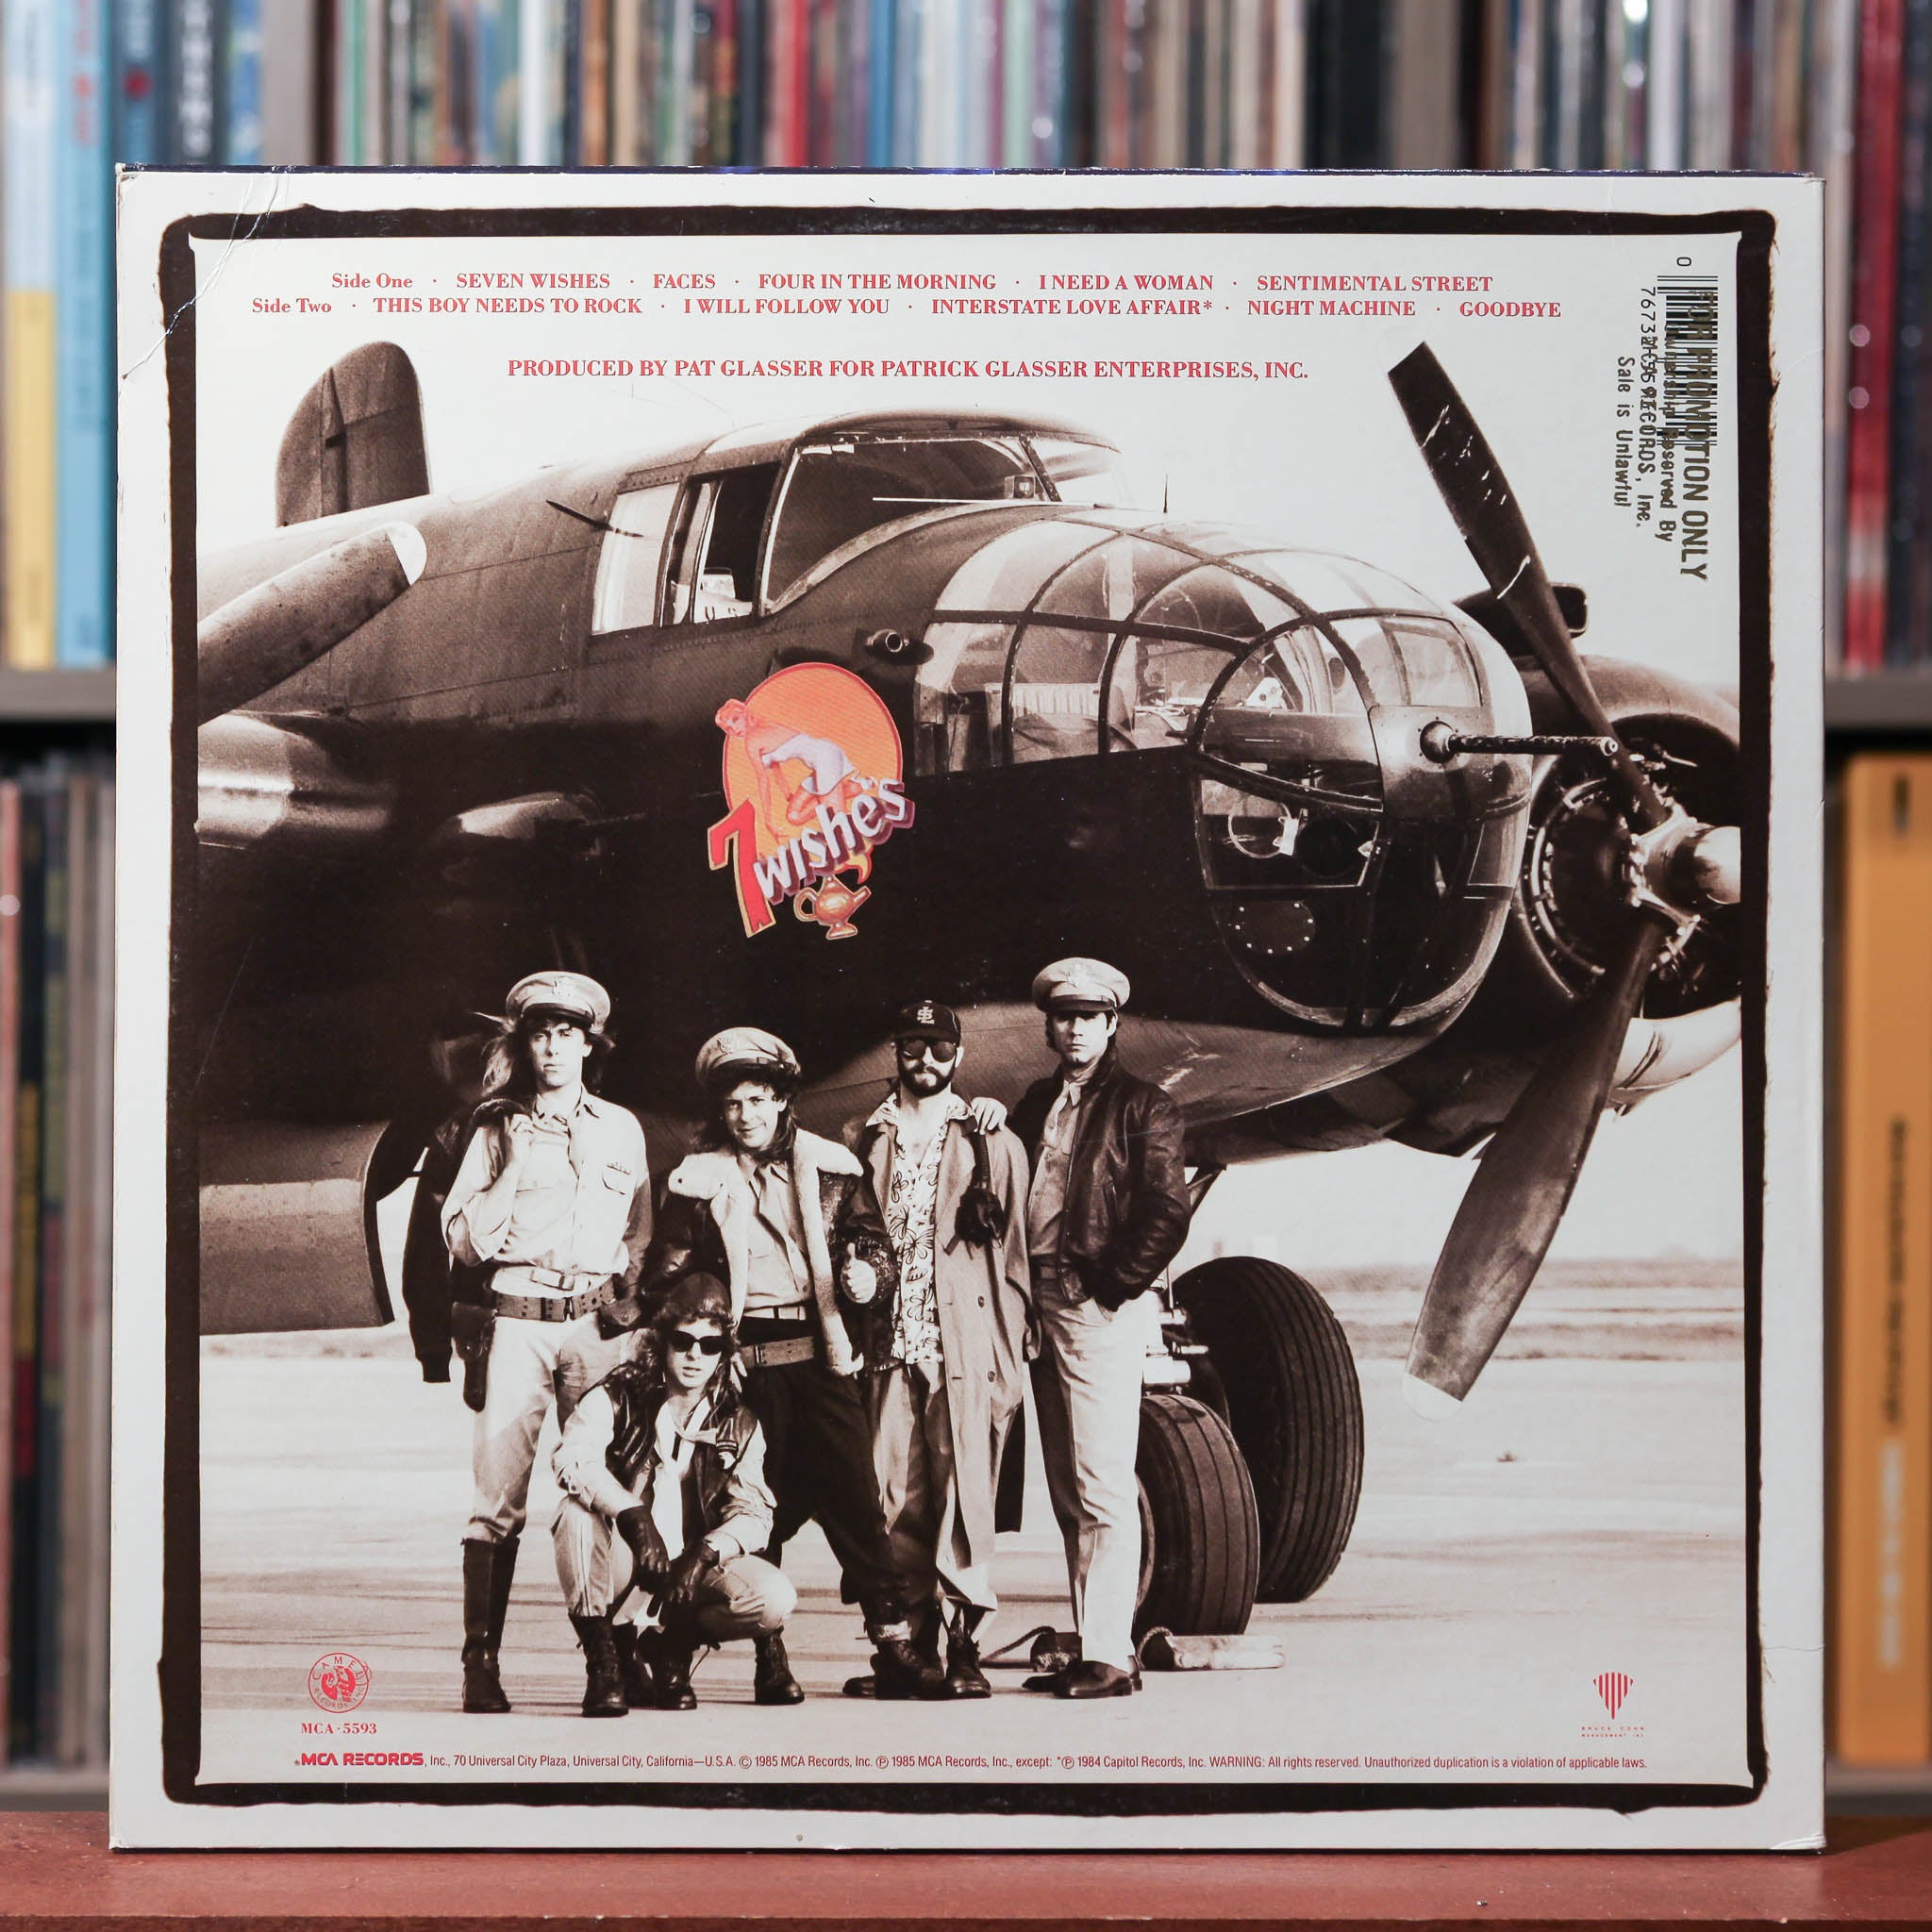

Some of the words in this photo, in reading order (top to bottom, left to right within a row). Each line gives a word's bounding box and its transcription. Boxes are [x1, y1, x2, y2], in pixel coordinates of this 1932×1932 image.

[331, 272, 371, 289] Side
[375, 272, 413, 289] One
[456, 273, 525, 289] SEVEN
[528, 273, 610, 289] WISHES
[652, 273, 716, 290] FACES
[758, 273, 816, 290] FOUR
[820, 274, 843, 290] IN
[847, 274, 891, 290] THE
[896, 274, 997, 291] MORNING
[1039, 274, 1047, 291] I
[1051, 274, 1110, 291] NEED
[1114, 275, 1129, 291] A
[1133, 275, 1214, 291] WOMAN
[1257, 275, 1407, 291] SENTIMENTAL
[1410, 275, 1493, 292] STREET
[252, 297, 291, 313] Side
[295, 297, 332, 313] Two
[373, 297, 423, 313] THIS
[428, 297, 471, 313] BOY
[475, 297, 545, 314] NEEDS
[549, 297, 579, 314] TO
[583, 297, 642, 314] ROCK
[683, 298, 691, 314] I
[695, 298, 751, 314] WILL
[754, 298, 843, 315] FOLLOW
[846, 298, 890, 314] YOU
[931, 298, 1061, 315] INTERSTATE
[1066, 298, 1122, 315] LOVE
[1247, 299, 1315, 316] NIGHT
[1319, 299, 1416, 317] MACHINE
[1458, 301, 1561, 318] GOODBYE
[1686, 289, 1715, 341] FOR
[508, 359, 634, 377] PRODUCED
[638, 359, 668, 376] BY
[674, 359, 716, 376] PAT
[720, 359, 824, 377] GLASSER
[828, 359, 875, 377] FOR
[880, 359, 980, 377] PATRICK
[985, 359, 1089, 378] GLASSER
[1093, 360, 1259, 382] ENTERPRISES,
[1264, 361, 1308, 379] INC.
[1616, 357, 1635, 393] Sale
[1616, 404, 1634, 418] is
[1681, 346, 1712, 502] PROMOTION
[1614, 430, 1633, 508] Unlawful
[1657, 427, 1679, 509] Reserved
[1636, 494, 1655, 528] Inc.
[1654, 520, 1676, 542] By
[1679, 509, 1709, 582] ONLY
[708, 799, 776, 938] 7
[300, 1752, 340, 1767] MCA
[429, 1754, 451, 1767] Inc.,
[453, 1754, 467, 1767] 70
[468, 1754, 516, 1767] Universal
[517, 1754, 538, 1769] City
[540, 1755, 571, 1769] Plaza,
[573, 1755, 620, 1767] Universal
[621, 1754, 643, 1770] City,
[754, 1755, 778, 1768] 1985
[780, 1755, 806, 1768] MCA
[808, 1755, 853, 1769] Records,
[855, 1755, 874, 1768] Inc.
[891, 1755, 916, 1768] 1985
[917, 1755, 943, 1768] MCA
[944, 1755, 990, 1769] Records,
[992, 1755, 1013, 1769] Inc.,
[1015, 1756, 1053, 1770] except:
[1076, 1755, 1102, 1768] 1984
[1103, 1755, 1139, 1771] Capitol
[1141, 1755, 1186, 1770] Records,
[1188, 1756, 1207, 1768] Inc.
[1208, 1753, 1265, 1769] WARNING:
[1267, 1756, 1281, 1769] All
[1283, 1755, 1313, 1771] rights
[1314, 1756, 1361, 1769] reserved.
[1364, 1756, 1432, 1769] Unauthorized
[1433, 1756, 1490, 1771] duplication
[1491, 1756, 1501, 1769] is
[1502, 1758, 1509, 1769] a
[1510, 1756, 1555, 1769] violation
[1556, 1756, 1567, 1769] of
[1568, 1756, 1620, 1771] applicable
[1622, 1756, 1648, 1769] laws.
